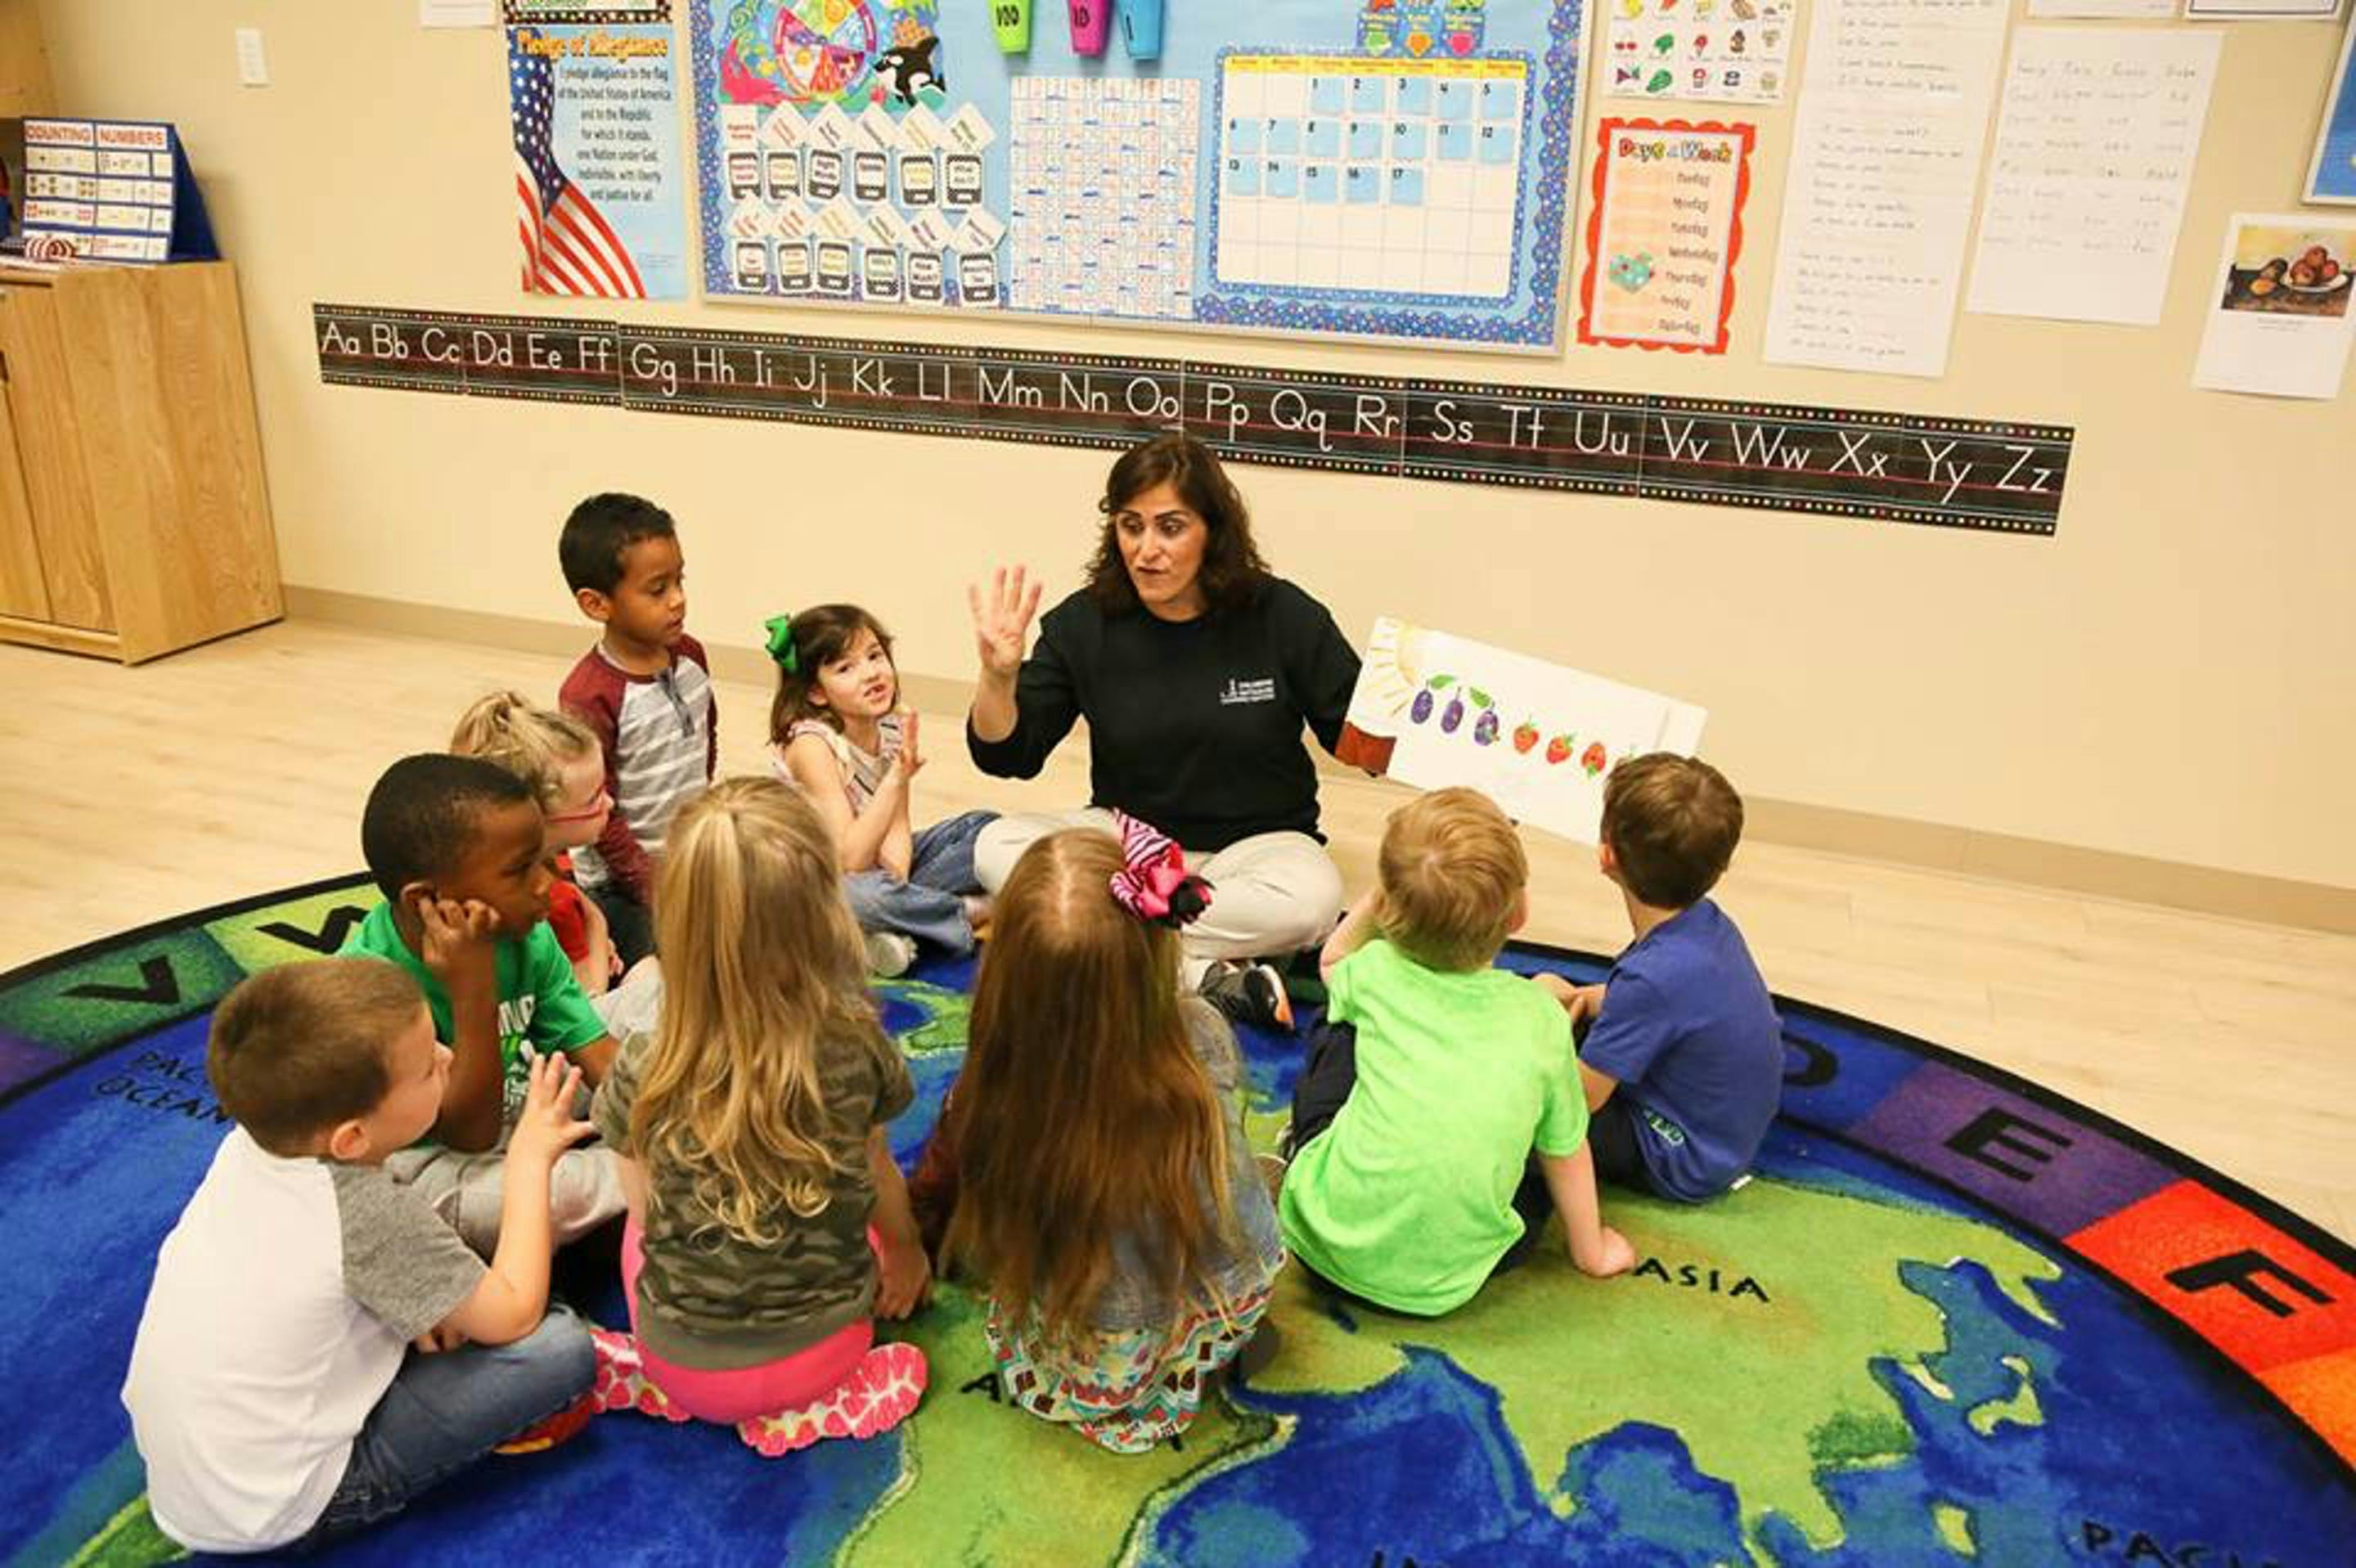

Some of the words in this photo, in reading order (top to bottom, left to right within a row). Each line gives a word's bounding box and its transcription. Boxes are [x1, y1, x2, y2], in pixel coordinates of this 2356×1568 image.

[1073, 6, 1090, 28] 10
[1126, 15, 1134, 41] 1
[1354, 78, 1361, 89] 2
[98, 127, 163, 146] NUMBERS
[321, 321, 360, 354] Aa
[372, 324, 408, 359] Bb
[422, 329, 460, 363] Cc
[473, 330, 514, 366] Dd
[528, 334, 562, 369] Ee
[579, 336, 611, 371] Ff
[632, 343, 677, 397] Gg
[694, 346, 735, 384] Hh
[754, 350, 772, 387] Ii
[794, 355, 826, 407] Jj
[852, 357, 893, 396] Kk
[919, 362, 950, 401] Ll
[979, 366, 1041, 407] Mm
[1060, 371, 1108, 413] Nn
[1126, 377, 1179, 417] Oo
[1207, 383, 1249, 443] Pp
[1270, 389, 1333, 452] Qq
[1355, 395, 1400, 438] Rr
[1432, 400, 1472, 443] Ss
[1500, 404, 1544, 448] Tt
[1575, 410, 1630, 456] Uu
[1661, 417, 1708, 461] Vv
[1732, 423, 1810, 469] Ww
[1829, 431, 1887, 478] Xx
[1922, 438, 1972, 505] Yy
[1996, 446, 2051, 491] Zz
[59, 955, 180, 1004] V
[1944, 1105, 2074, 1183] E
[1634, 1256, 1770, 1303] ASIA
[2163, 1249, 2338, 1319] F
